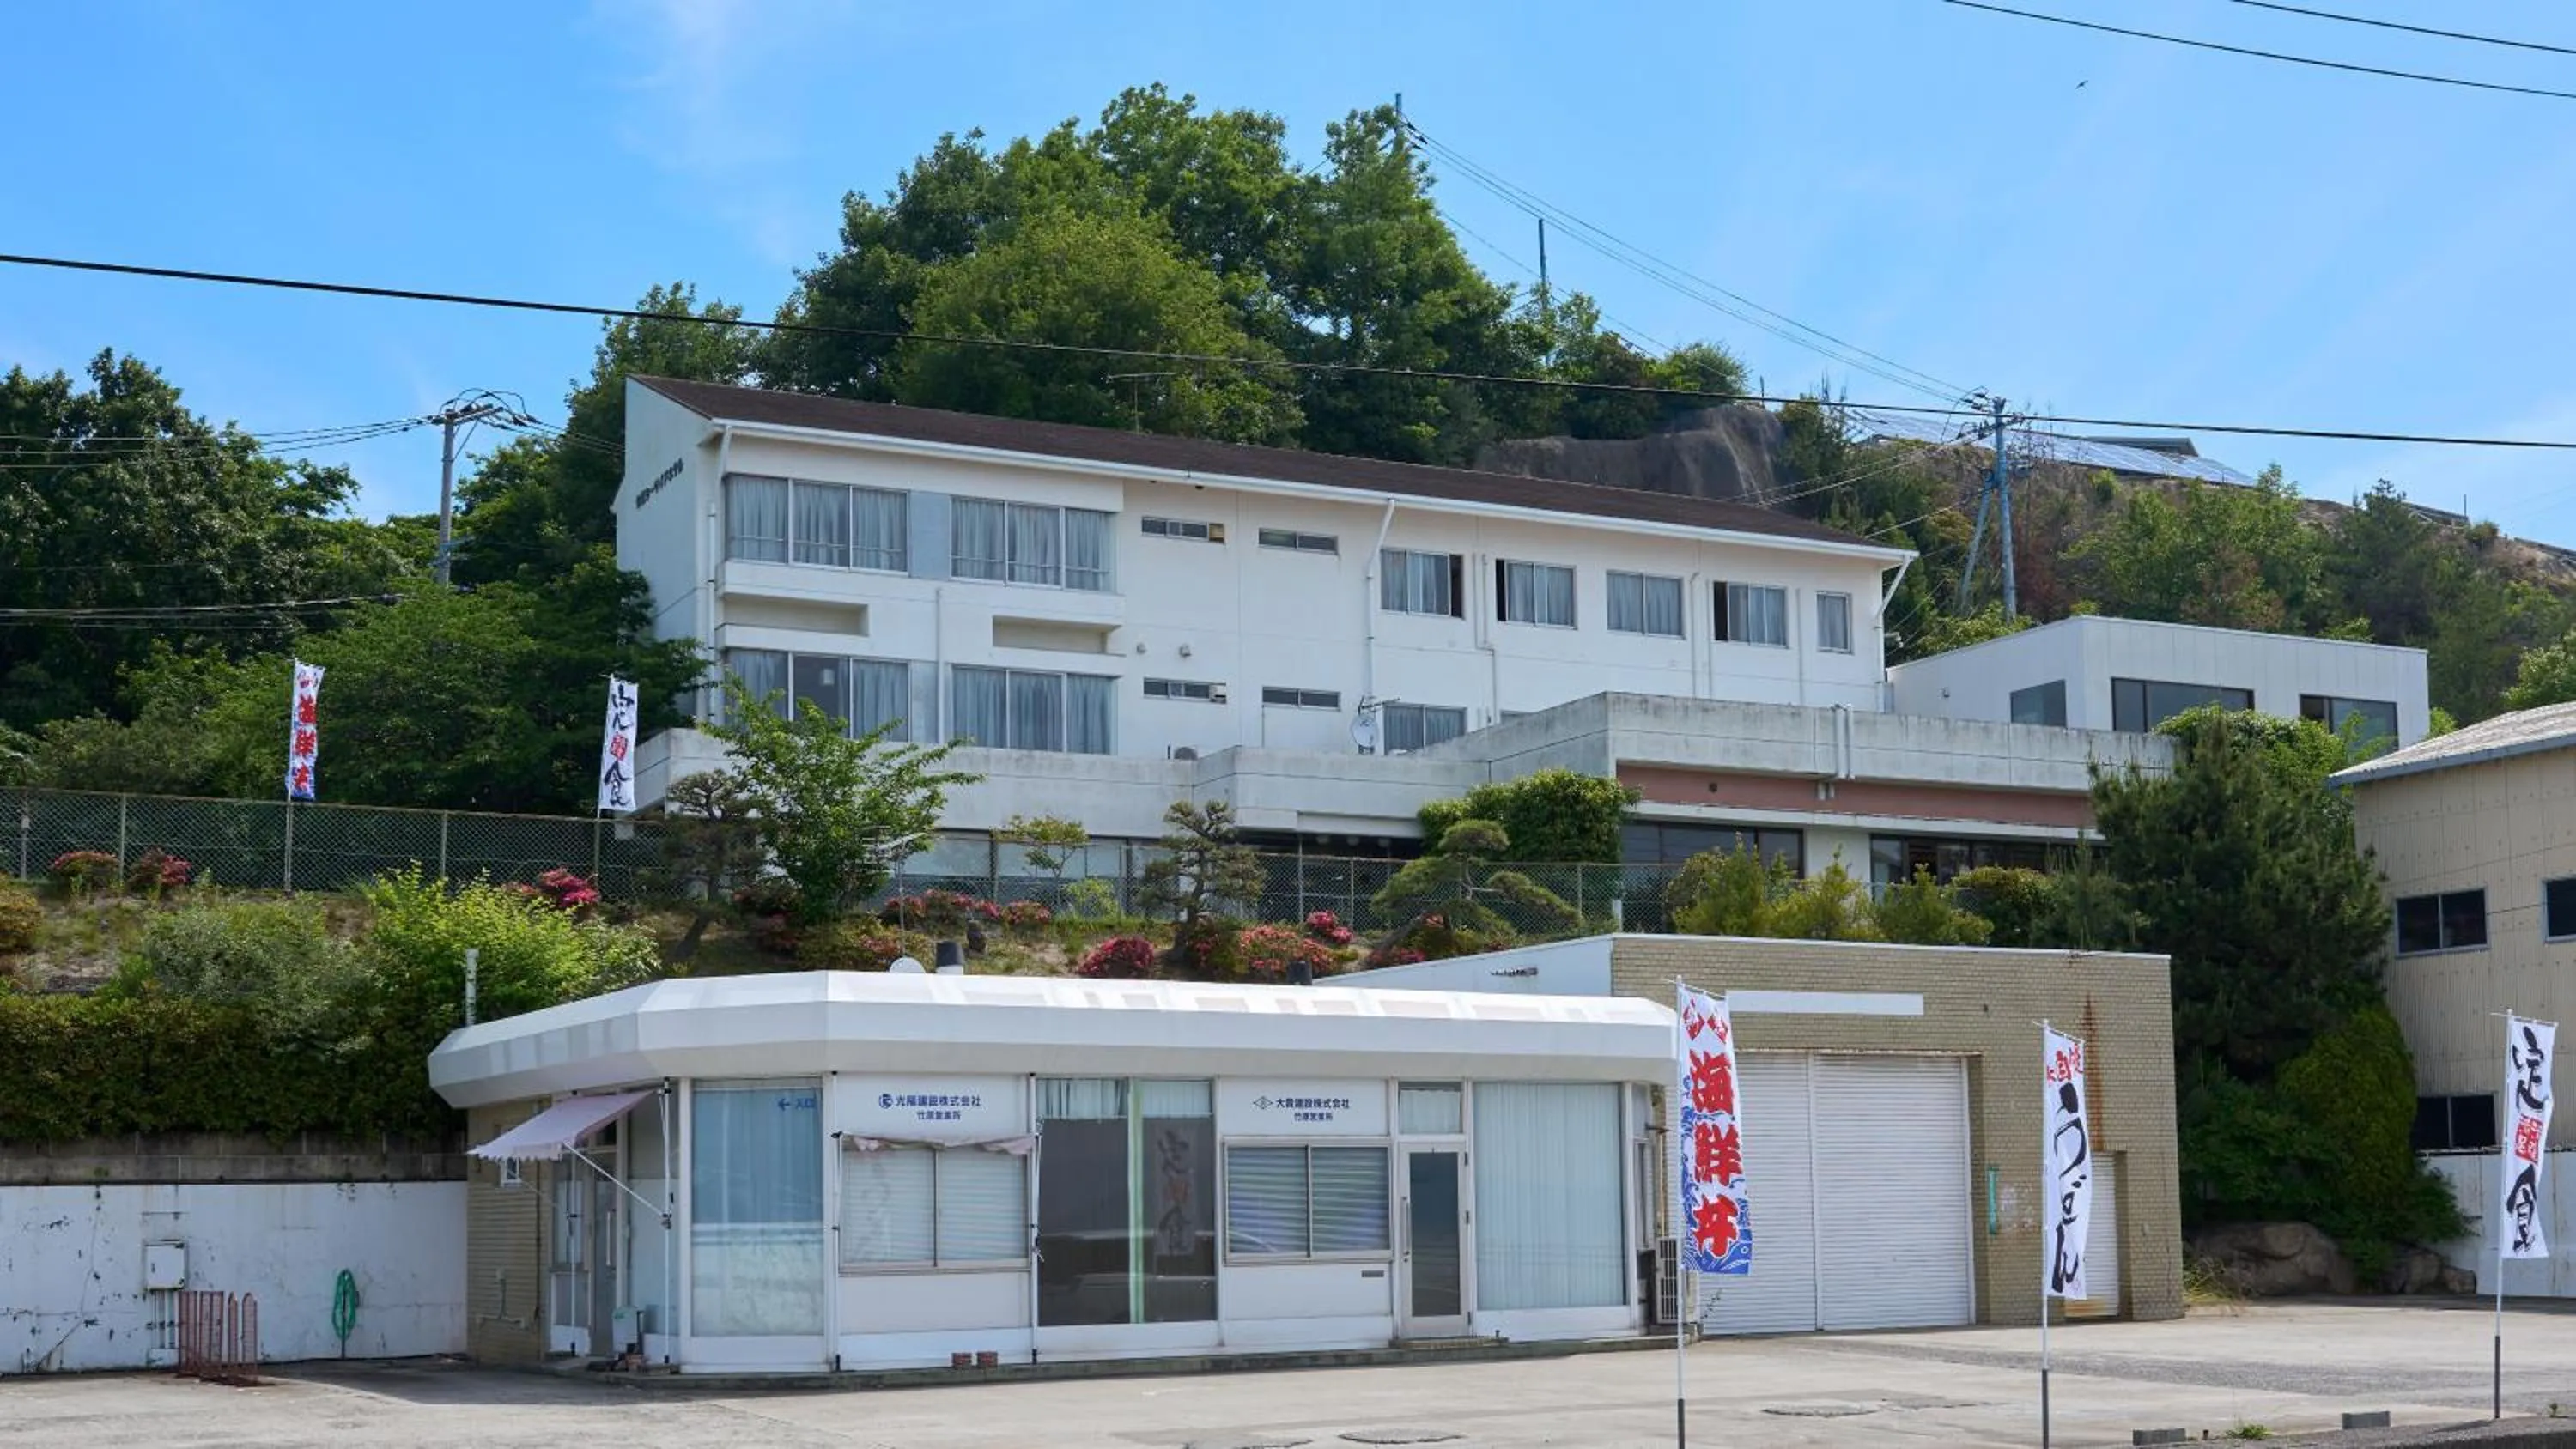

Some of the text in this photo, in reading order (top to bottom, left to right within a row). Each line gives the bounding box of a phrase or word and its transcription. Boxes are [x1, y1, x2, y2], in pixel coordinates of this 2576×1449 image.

[1690, 1050, 1742, 1258] 海鮮丼
[2051, 1082, 2087, 1293] うどん
[2506, 1026, 2549, 1252] 定食
